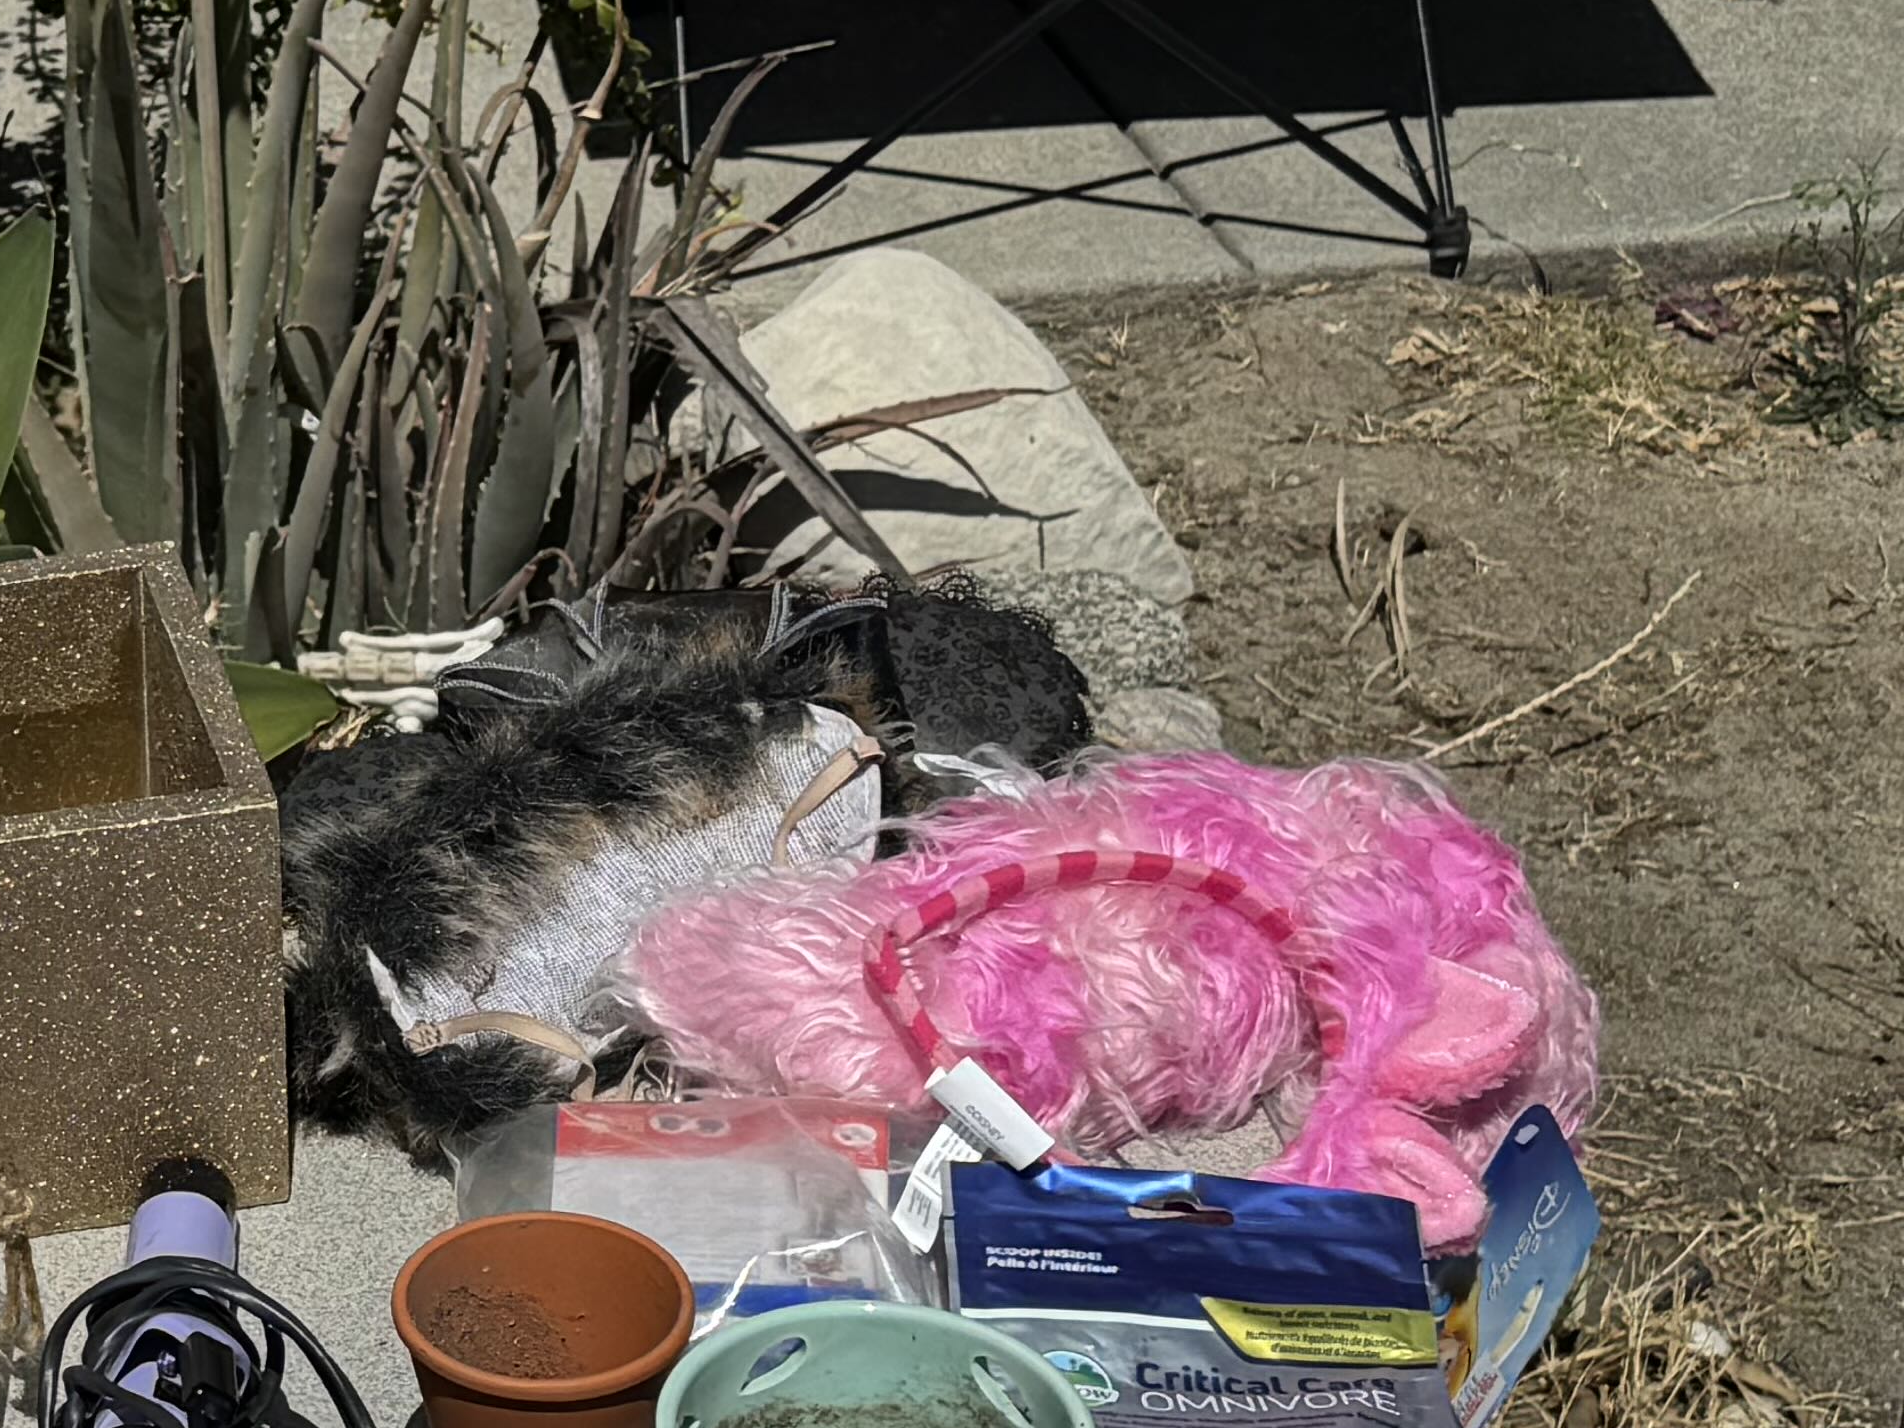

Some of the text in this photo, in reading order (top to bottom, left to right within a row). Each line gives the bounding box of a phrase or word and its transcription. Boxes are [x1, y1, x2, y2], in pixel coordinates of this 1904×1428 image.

[985, 1246, 1040, 1258] SCOOP
[1487, 1180, 1571, 1301] Disney
[1135, 1360, 1290, 1396] Critical
[1297, 1376, 1396, 1394] Care
[1140, 1389, 1401, 1417] OMNIVORE
